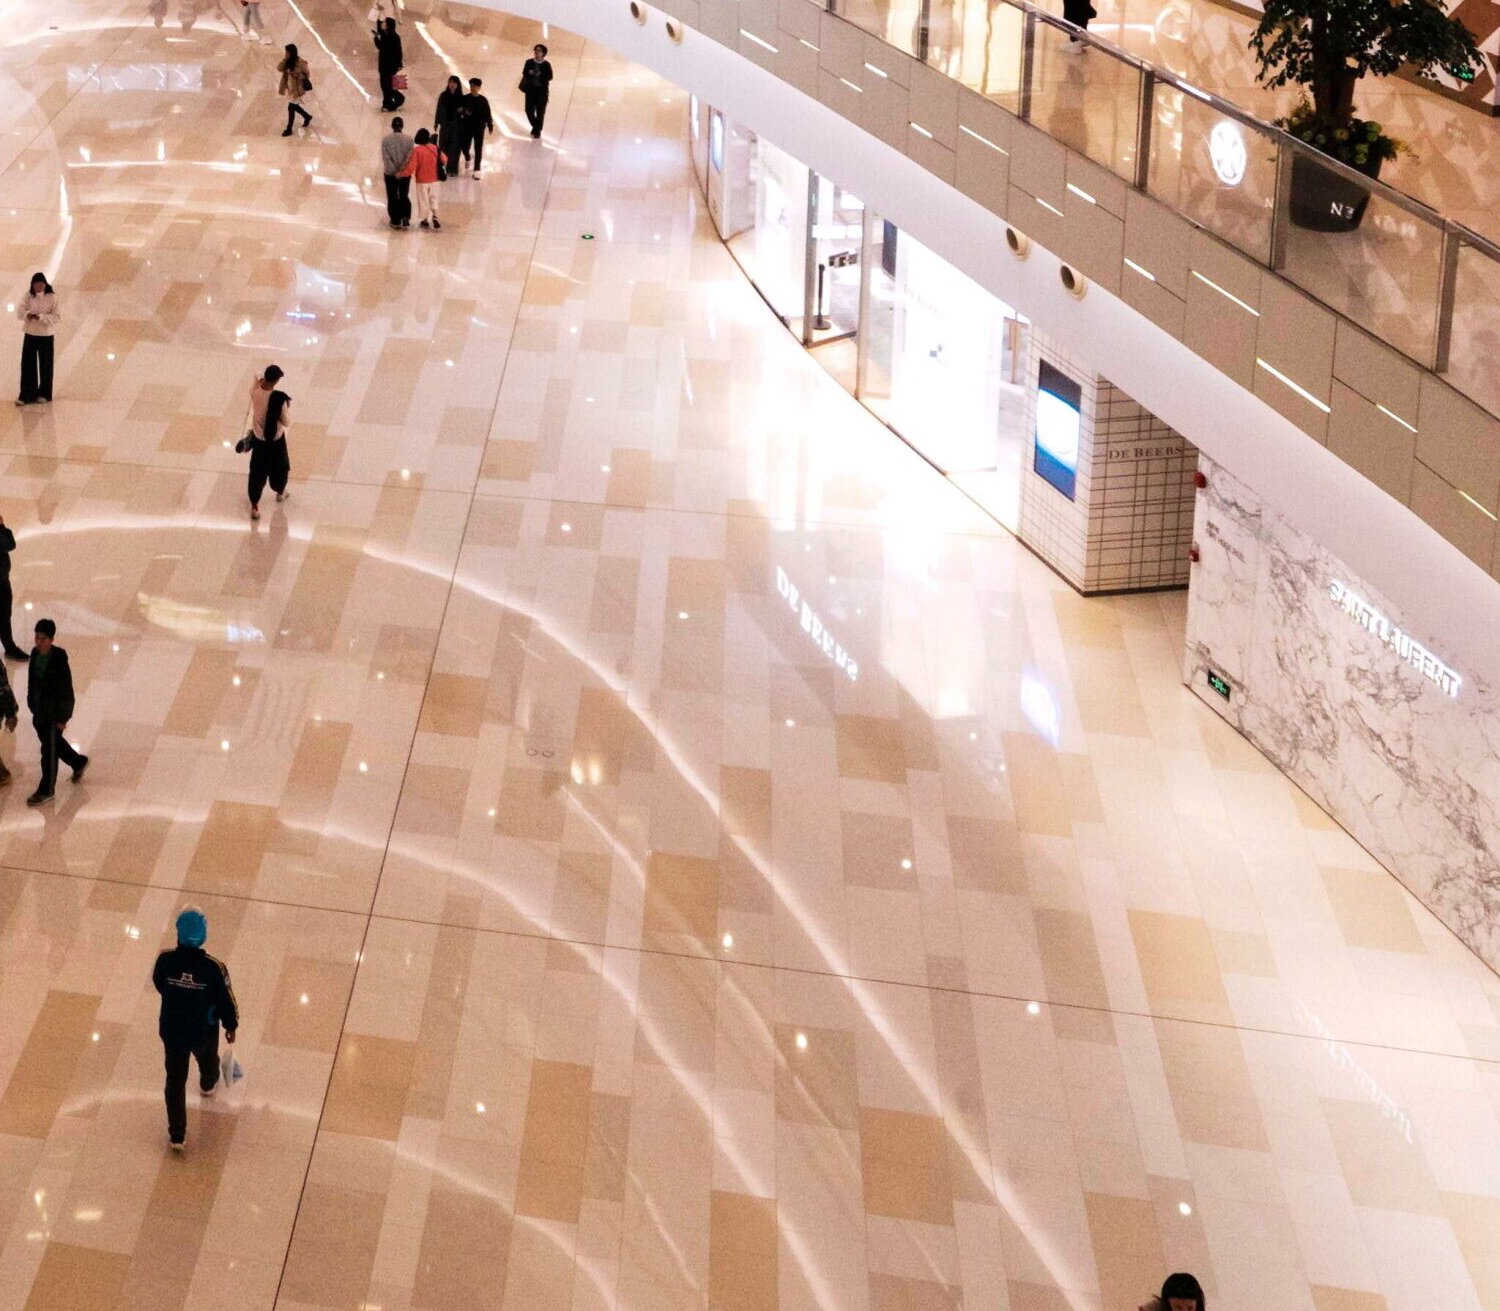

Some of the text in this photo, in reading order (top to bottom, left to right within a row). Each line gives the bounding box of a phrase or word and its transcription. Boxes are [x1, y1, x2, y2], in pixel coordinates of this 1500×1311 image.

[1109, 449, 1130, 460] DE
[1328, 577, 1463, 698] SAINT LAURENT
